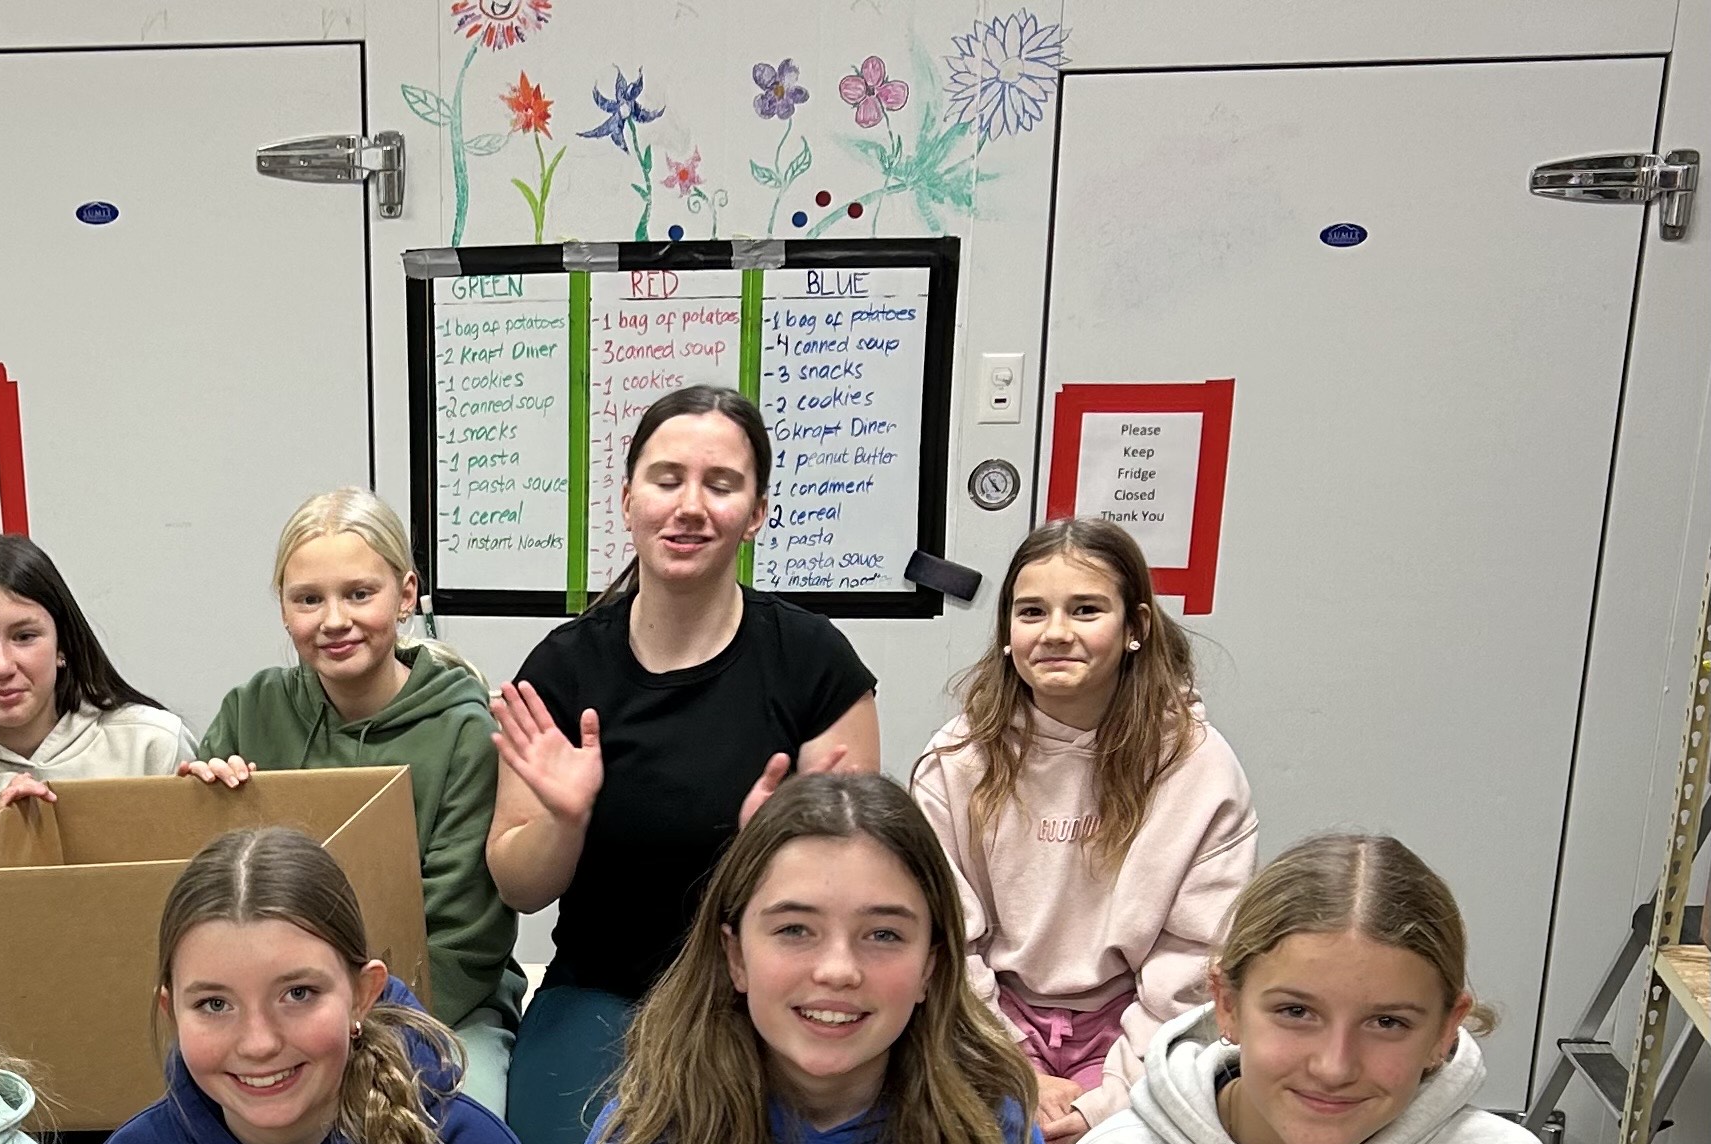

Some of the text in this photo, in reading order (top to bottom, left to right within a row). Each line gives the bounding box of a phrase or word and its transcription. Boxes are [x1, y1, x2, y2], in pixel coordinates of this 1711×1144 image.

[451, 274, 524, 300] GREEN
[630, 270, 680, 298] RED
[806, 270, 871, 296] BLUE
[455, 318, 479, 340] bag
[482, 320, 501, 336] of
[505, 313, 566, 336] potatoes
[618, 310, 648, 336] bag
[655, 311, 677, 333] of
[786, 309, 817, 335] bag
[825, 311, 844, 332] of
[679, 340, 726, 367] soup
[856, 336, 900, 357] soup
[461, 369, 526, 392] cookies
[622, 368, 684, 391] cookies
[799, 358, 864, 380] snacks
[516, 395, 555, 418] soup
[796, 385, 875, 411] cookies
[1120, 424, 1161, 436] Please
[467, 448, 520, 475] pasta
[795, 446, 850, 475] peanut
[853, 446, 898, 465] Butter
[1123, 447, 1155, 460] Keep
[1117, 468, 1157, 481] Fridge
[468, 475, 516, 499] pasta
[522, 476, 568, 493] sauce
[1114, 489, 1156, 501] Closed
[469, 500, 524, 526] cereal
[790, 502, 842, 526] cereal
[1100, 510, 1165, 523] Thank You
[467, 532, 513, 551] instant
[786, 527, 834, 551] pasta
[785, 552, 835, 575] pasta
[788, 572, 835, 588] instant
